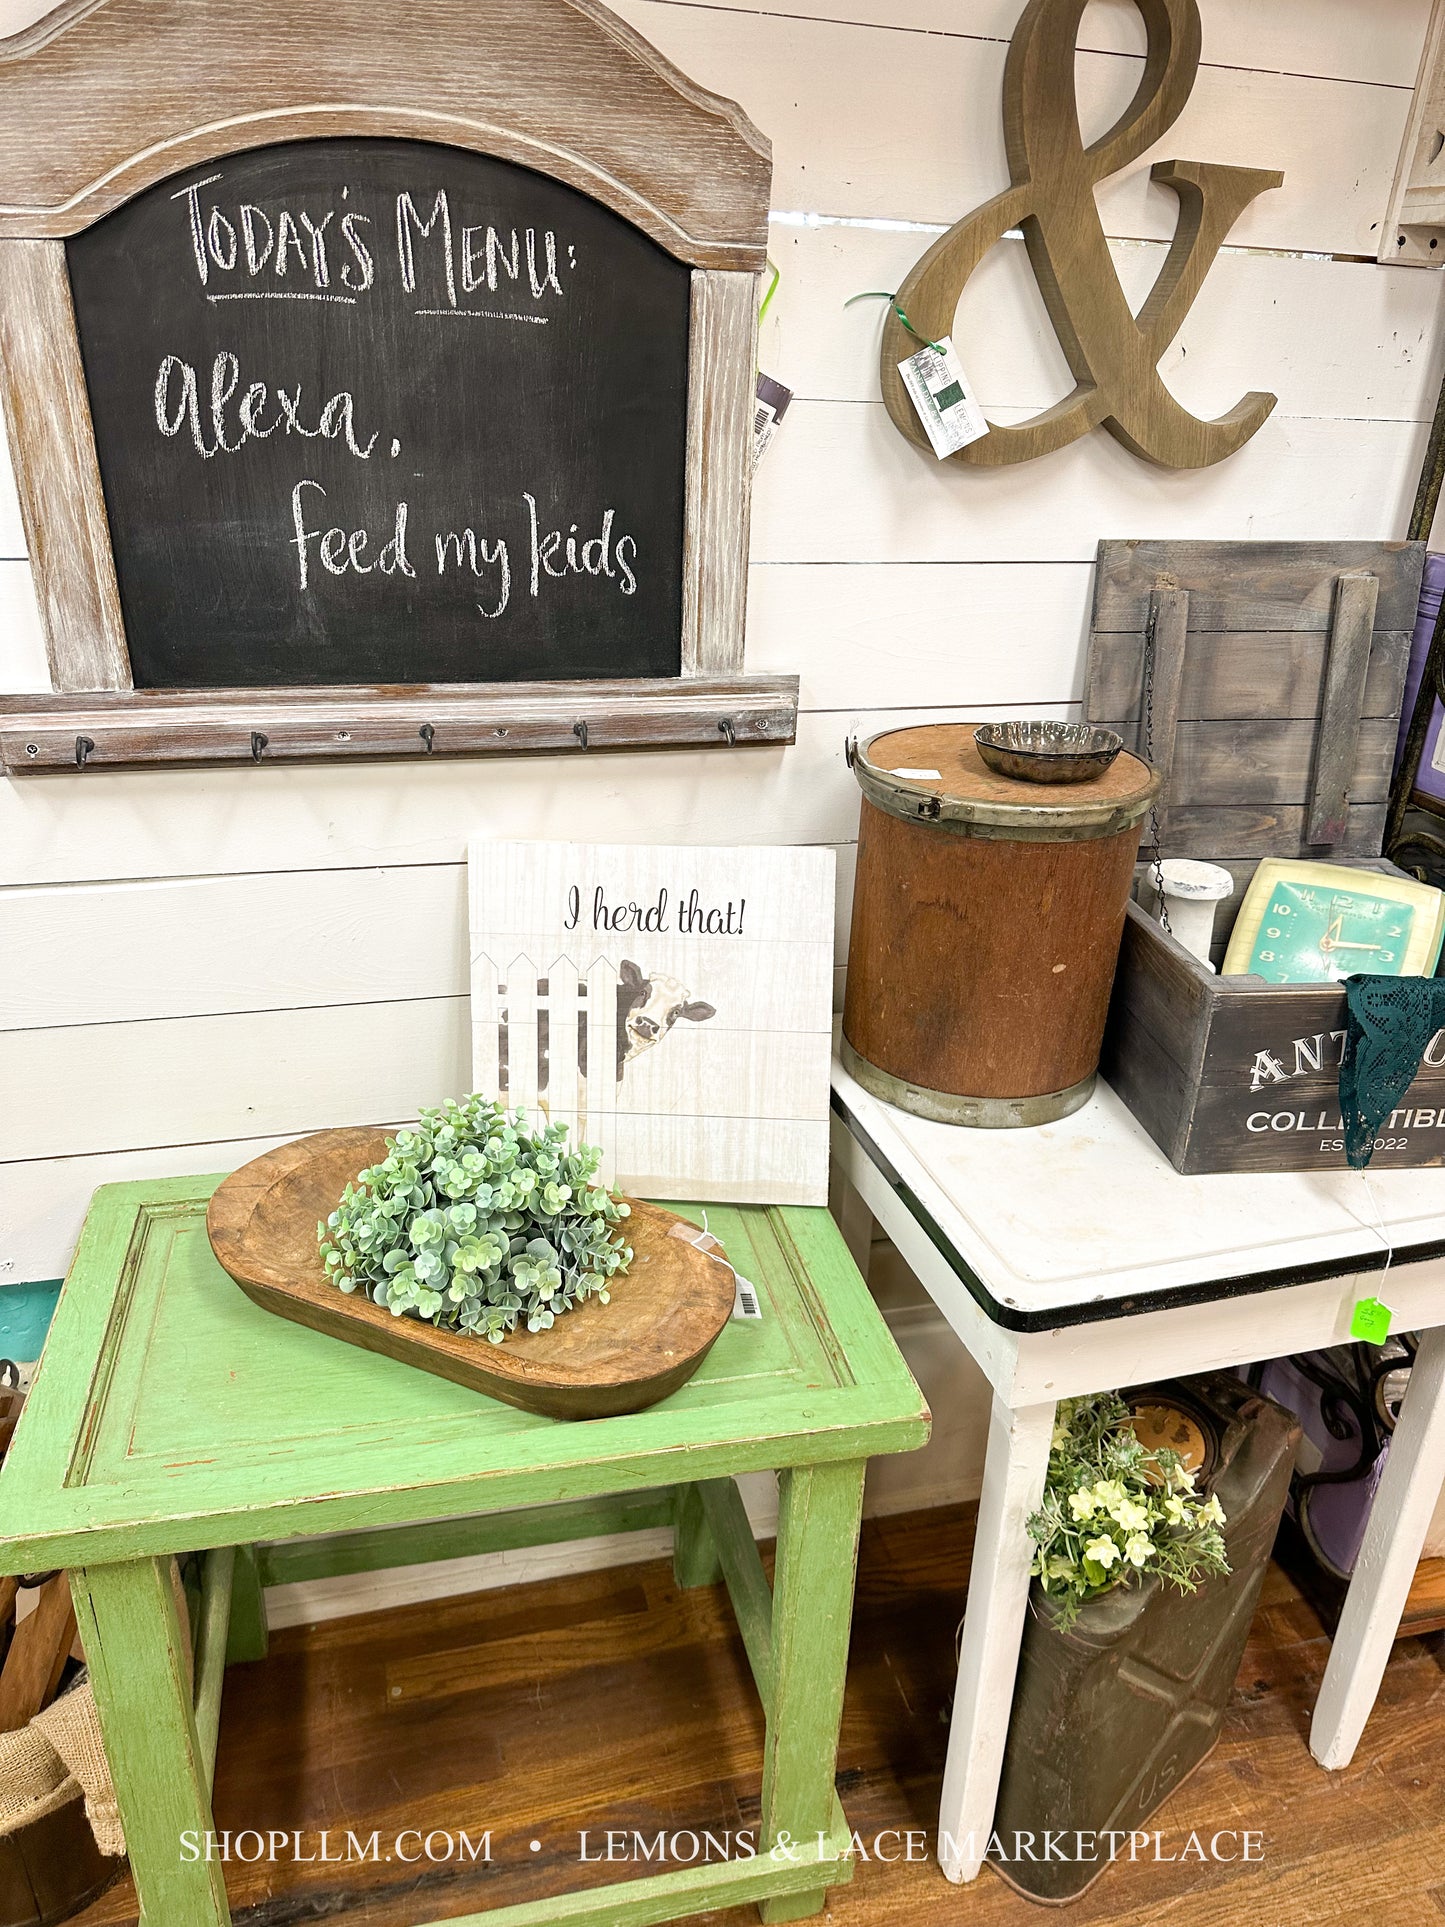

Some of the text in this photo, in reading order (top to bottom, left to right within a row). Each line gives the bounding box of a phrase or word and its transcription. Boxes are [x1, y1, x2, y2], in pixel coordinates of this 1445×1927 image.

[290, 479, 638, 618] feed my kids
[563, 885, 746, 935] I herd that!
[1272, 903, 1291, 916] 10
[1266, 927, 1281, 939] 9
[1387, 926, 1402, 938] 2
[1259, 950, 1276, 962] 8
[1378, 950, 1395, 963] 3
[1249, 1028, 1445, 1093] ANTU
[1246, 1107, 1445, 1133] COLLTIBL
[1319, 1138, 1347, 1152] ES
